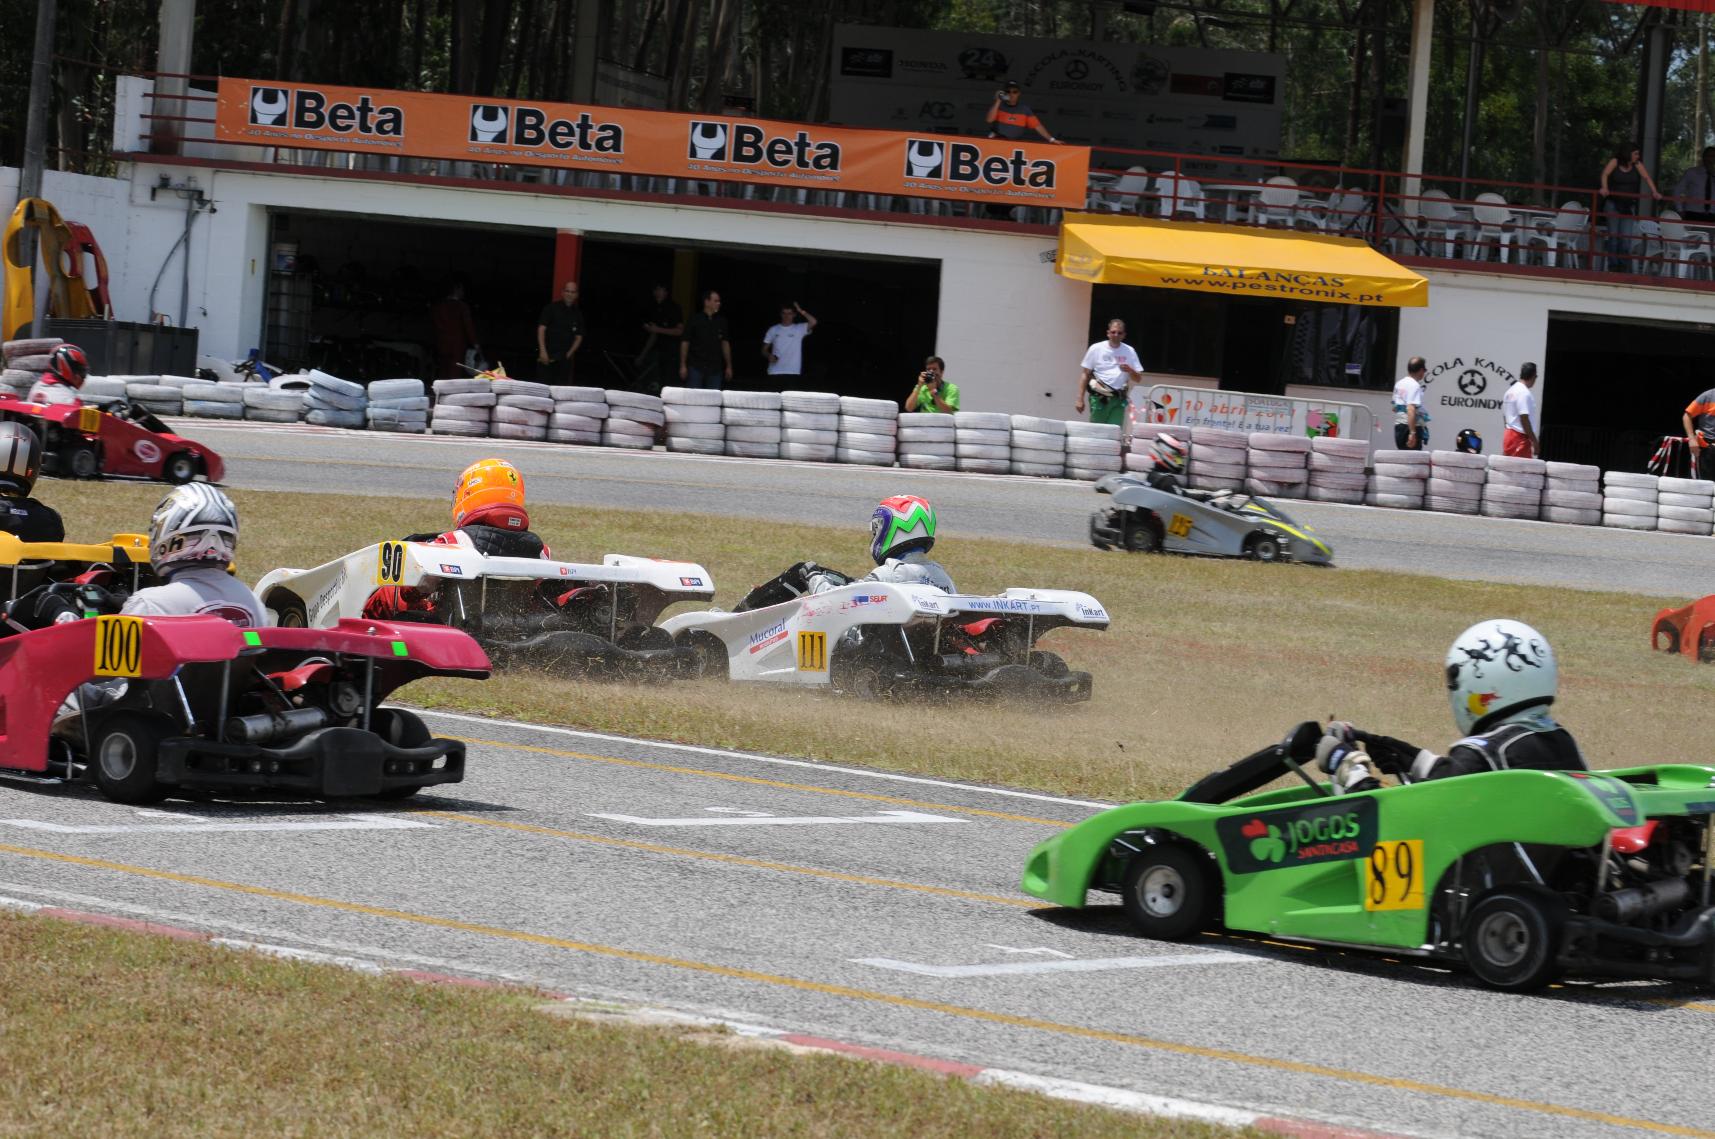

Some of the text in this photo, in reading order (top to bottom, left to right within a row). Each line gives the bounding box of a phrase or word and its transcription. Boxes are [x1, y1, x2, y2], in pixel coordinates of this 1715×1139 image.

[293, 89, 404, 137] Beta
[513, 106, 624, 154] Beta
[732, 123, 841, 172] Beta
[948, 142, 1056, 189] Beta
[1160, 277, 1384, 303] www.pestronix.pt
[1185, 400, 1204, 413] 10
[1440, 395, 1504, 410] EUROINDY
[382, 542, 403, 582] 90
[98, 619, 142, 673] 100
[750, 618, 785, 645] Mucoral
[801, 634, 825, 670] 111
[1287, 813, 1360, 853] JOGOS
[1371, 842, 1413, 905] 89
